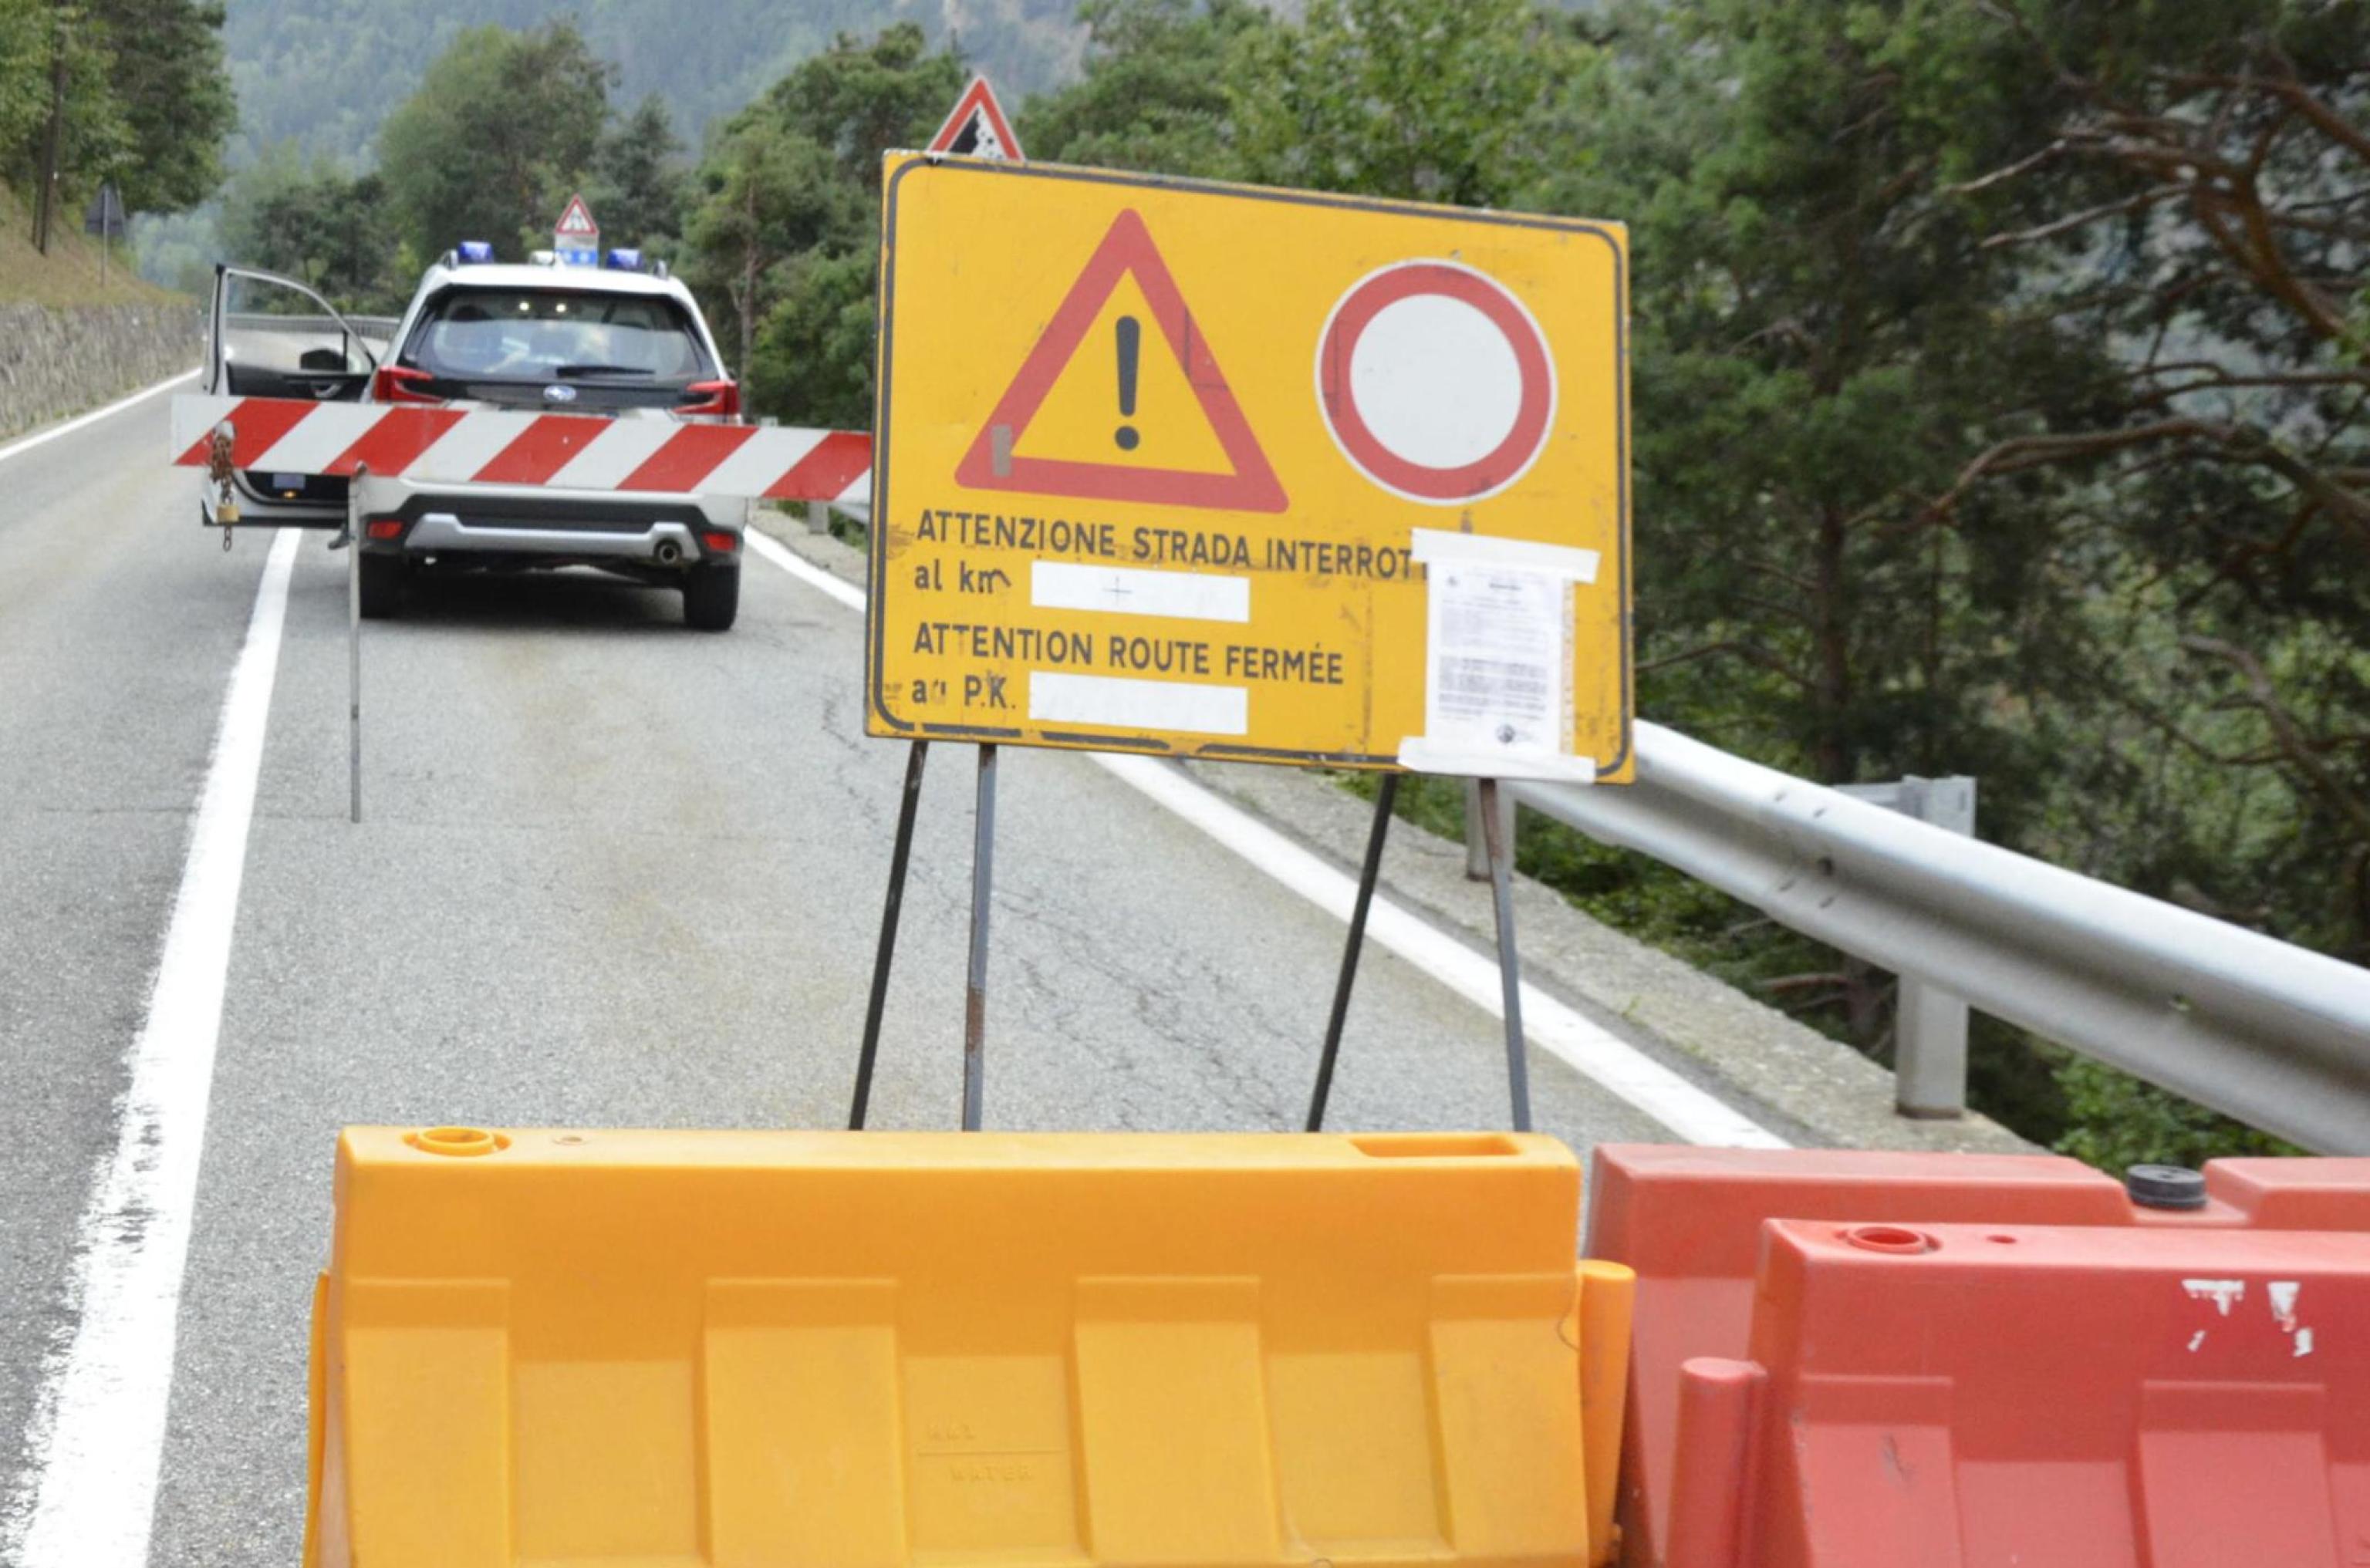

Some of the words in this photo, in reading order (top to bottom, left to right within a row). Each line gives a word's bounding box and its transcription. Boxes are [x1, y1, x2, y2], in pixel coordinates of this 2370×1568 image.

[917, 508, 1116, 557] ATTENZIONE
[1132, 526, 1251, 569] STRADA
[1267, 538, 1429, 581] INTERROT
[914, 558, 943, 592] al
[913, 622, 1092, 666] ATTENTION
[1109, 636, 1210, 675] ROUTE
[1225, 642, 1344, 685] FERMÉE
[964, 673, 1017, 710] P.K.
